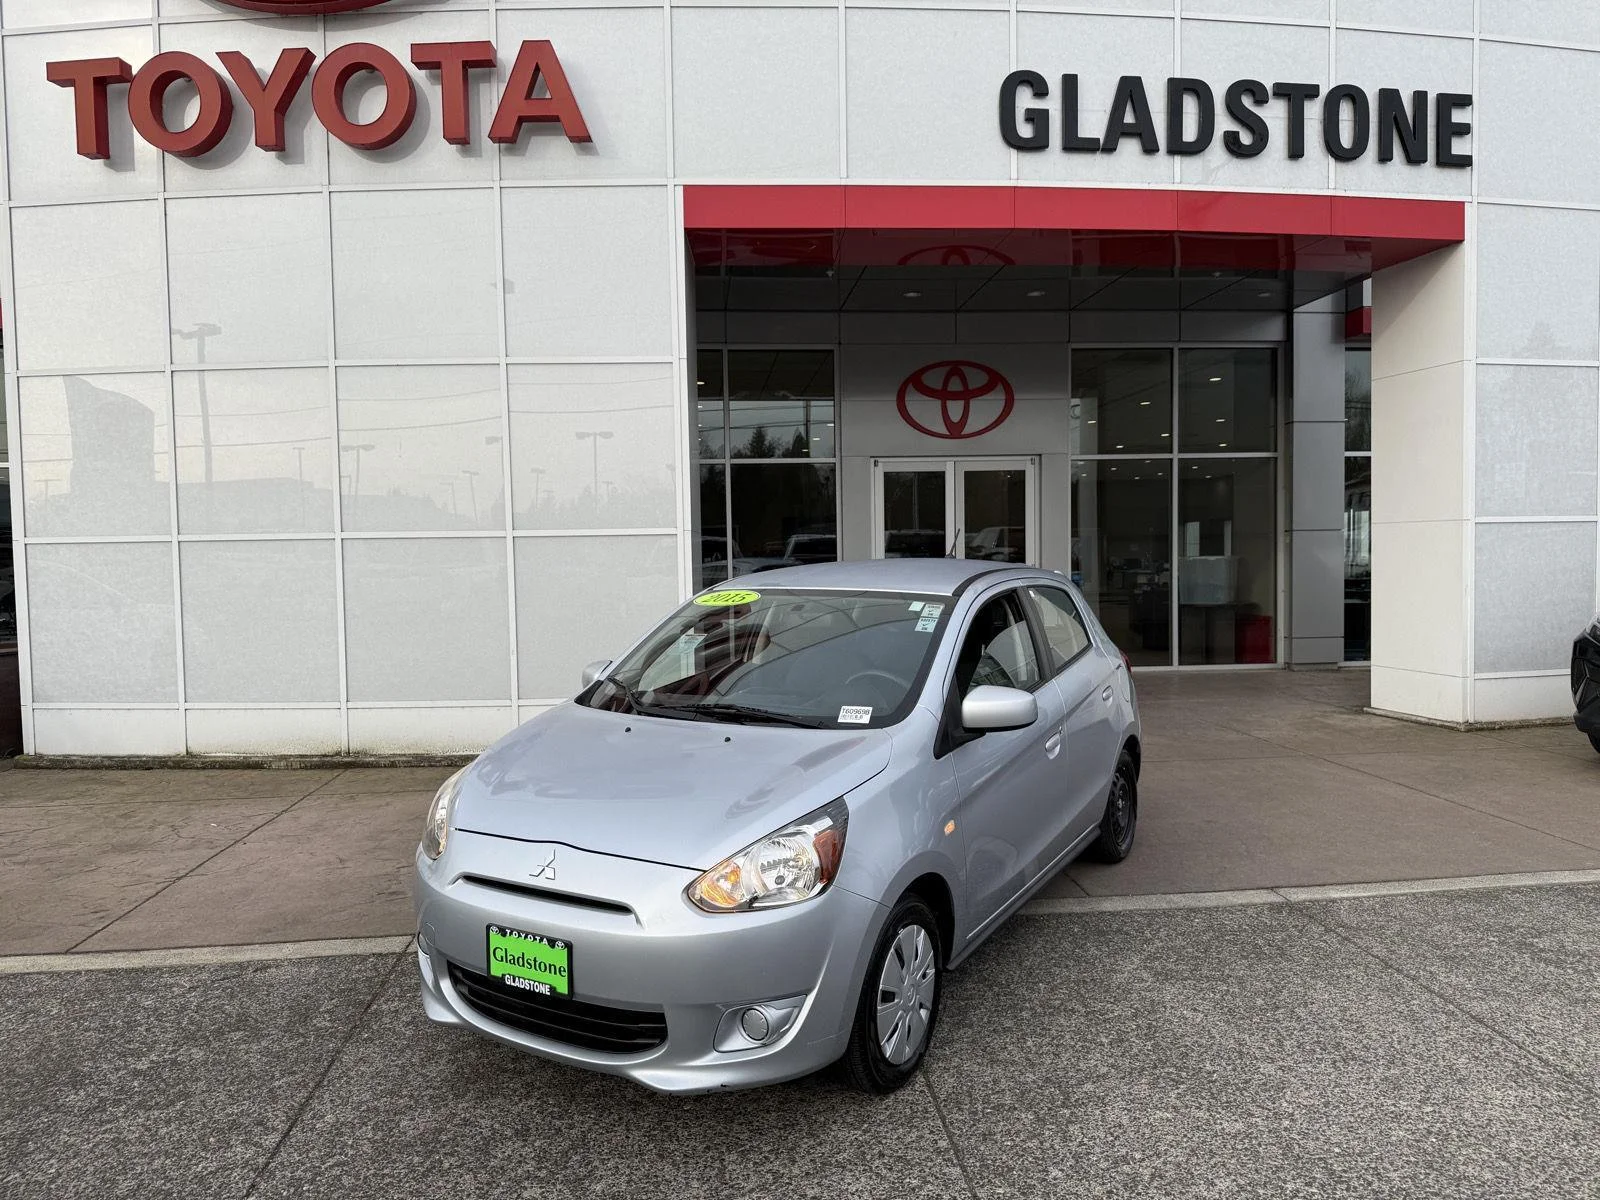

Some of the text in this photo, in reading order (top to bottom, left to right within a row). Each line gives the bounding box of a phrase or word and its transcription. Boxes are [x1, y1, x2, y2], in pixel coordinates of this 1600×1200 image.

[46, 39, 593, 160] TOYOTA
[999, 69, 1473, 168] GLADSTONE
[505, 929, 549, 946] TOYOTA
[492, 946, 567, 978] Gladstone
[505, 974, 551, 995] GLADSTONE
